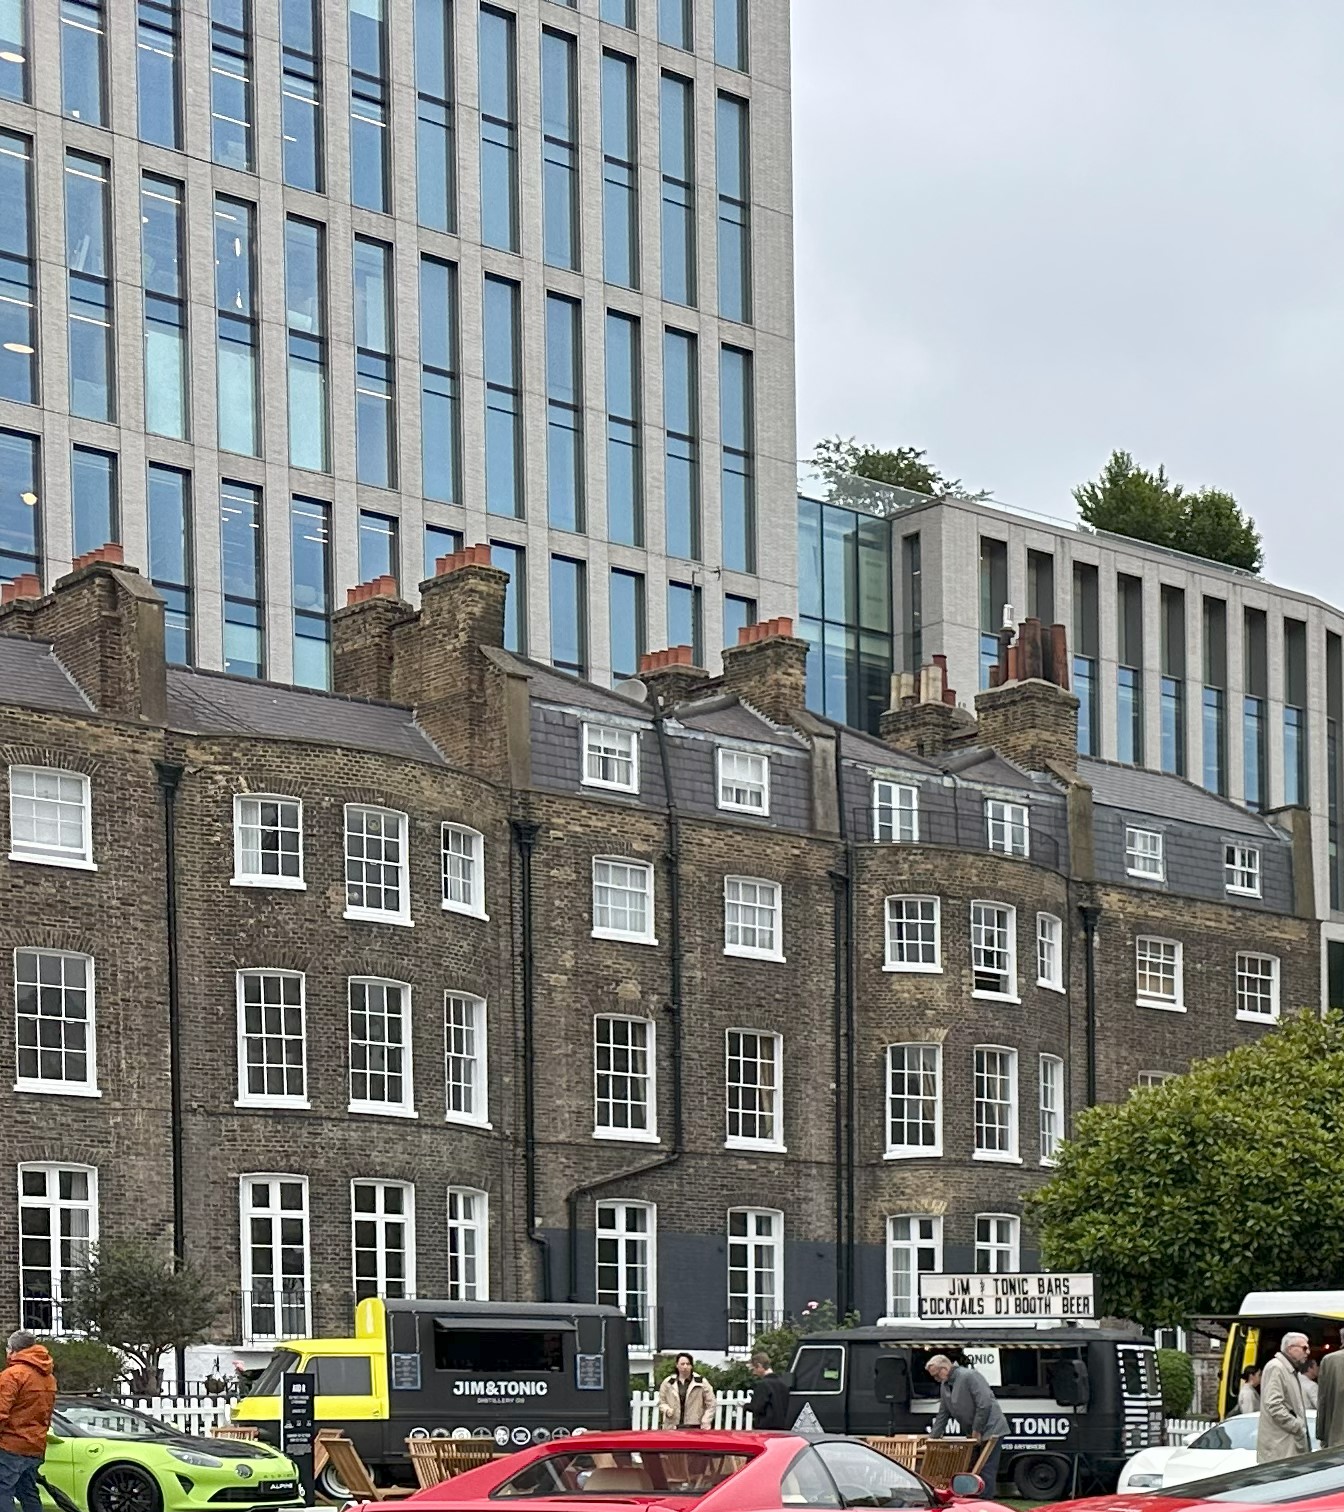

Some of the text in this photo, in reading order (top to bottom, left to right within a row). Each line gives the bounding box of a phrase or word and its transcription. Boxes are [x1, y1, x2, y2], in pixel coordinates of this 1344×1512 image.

[993, 1278, 1029, 1295] TONIC
[1038, 1278, 1070, 1295] BARS
[921, 1296, 1090, 1315] COCKTAILS DJ BOOTH BEER
[967, 1354, 995, 1365] ONIC
[452, 1381, 548, 1396] JIM&TONIC
[1011, 1417, 1070, 1435] TONIC
